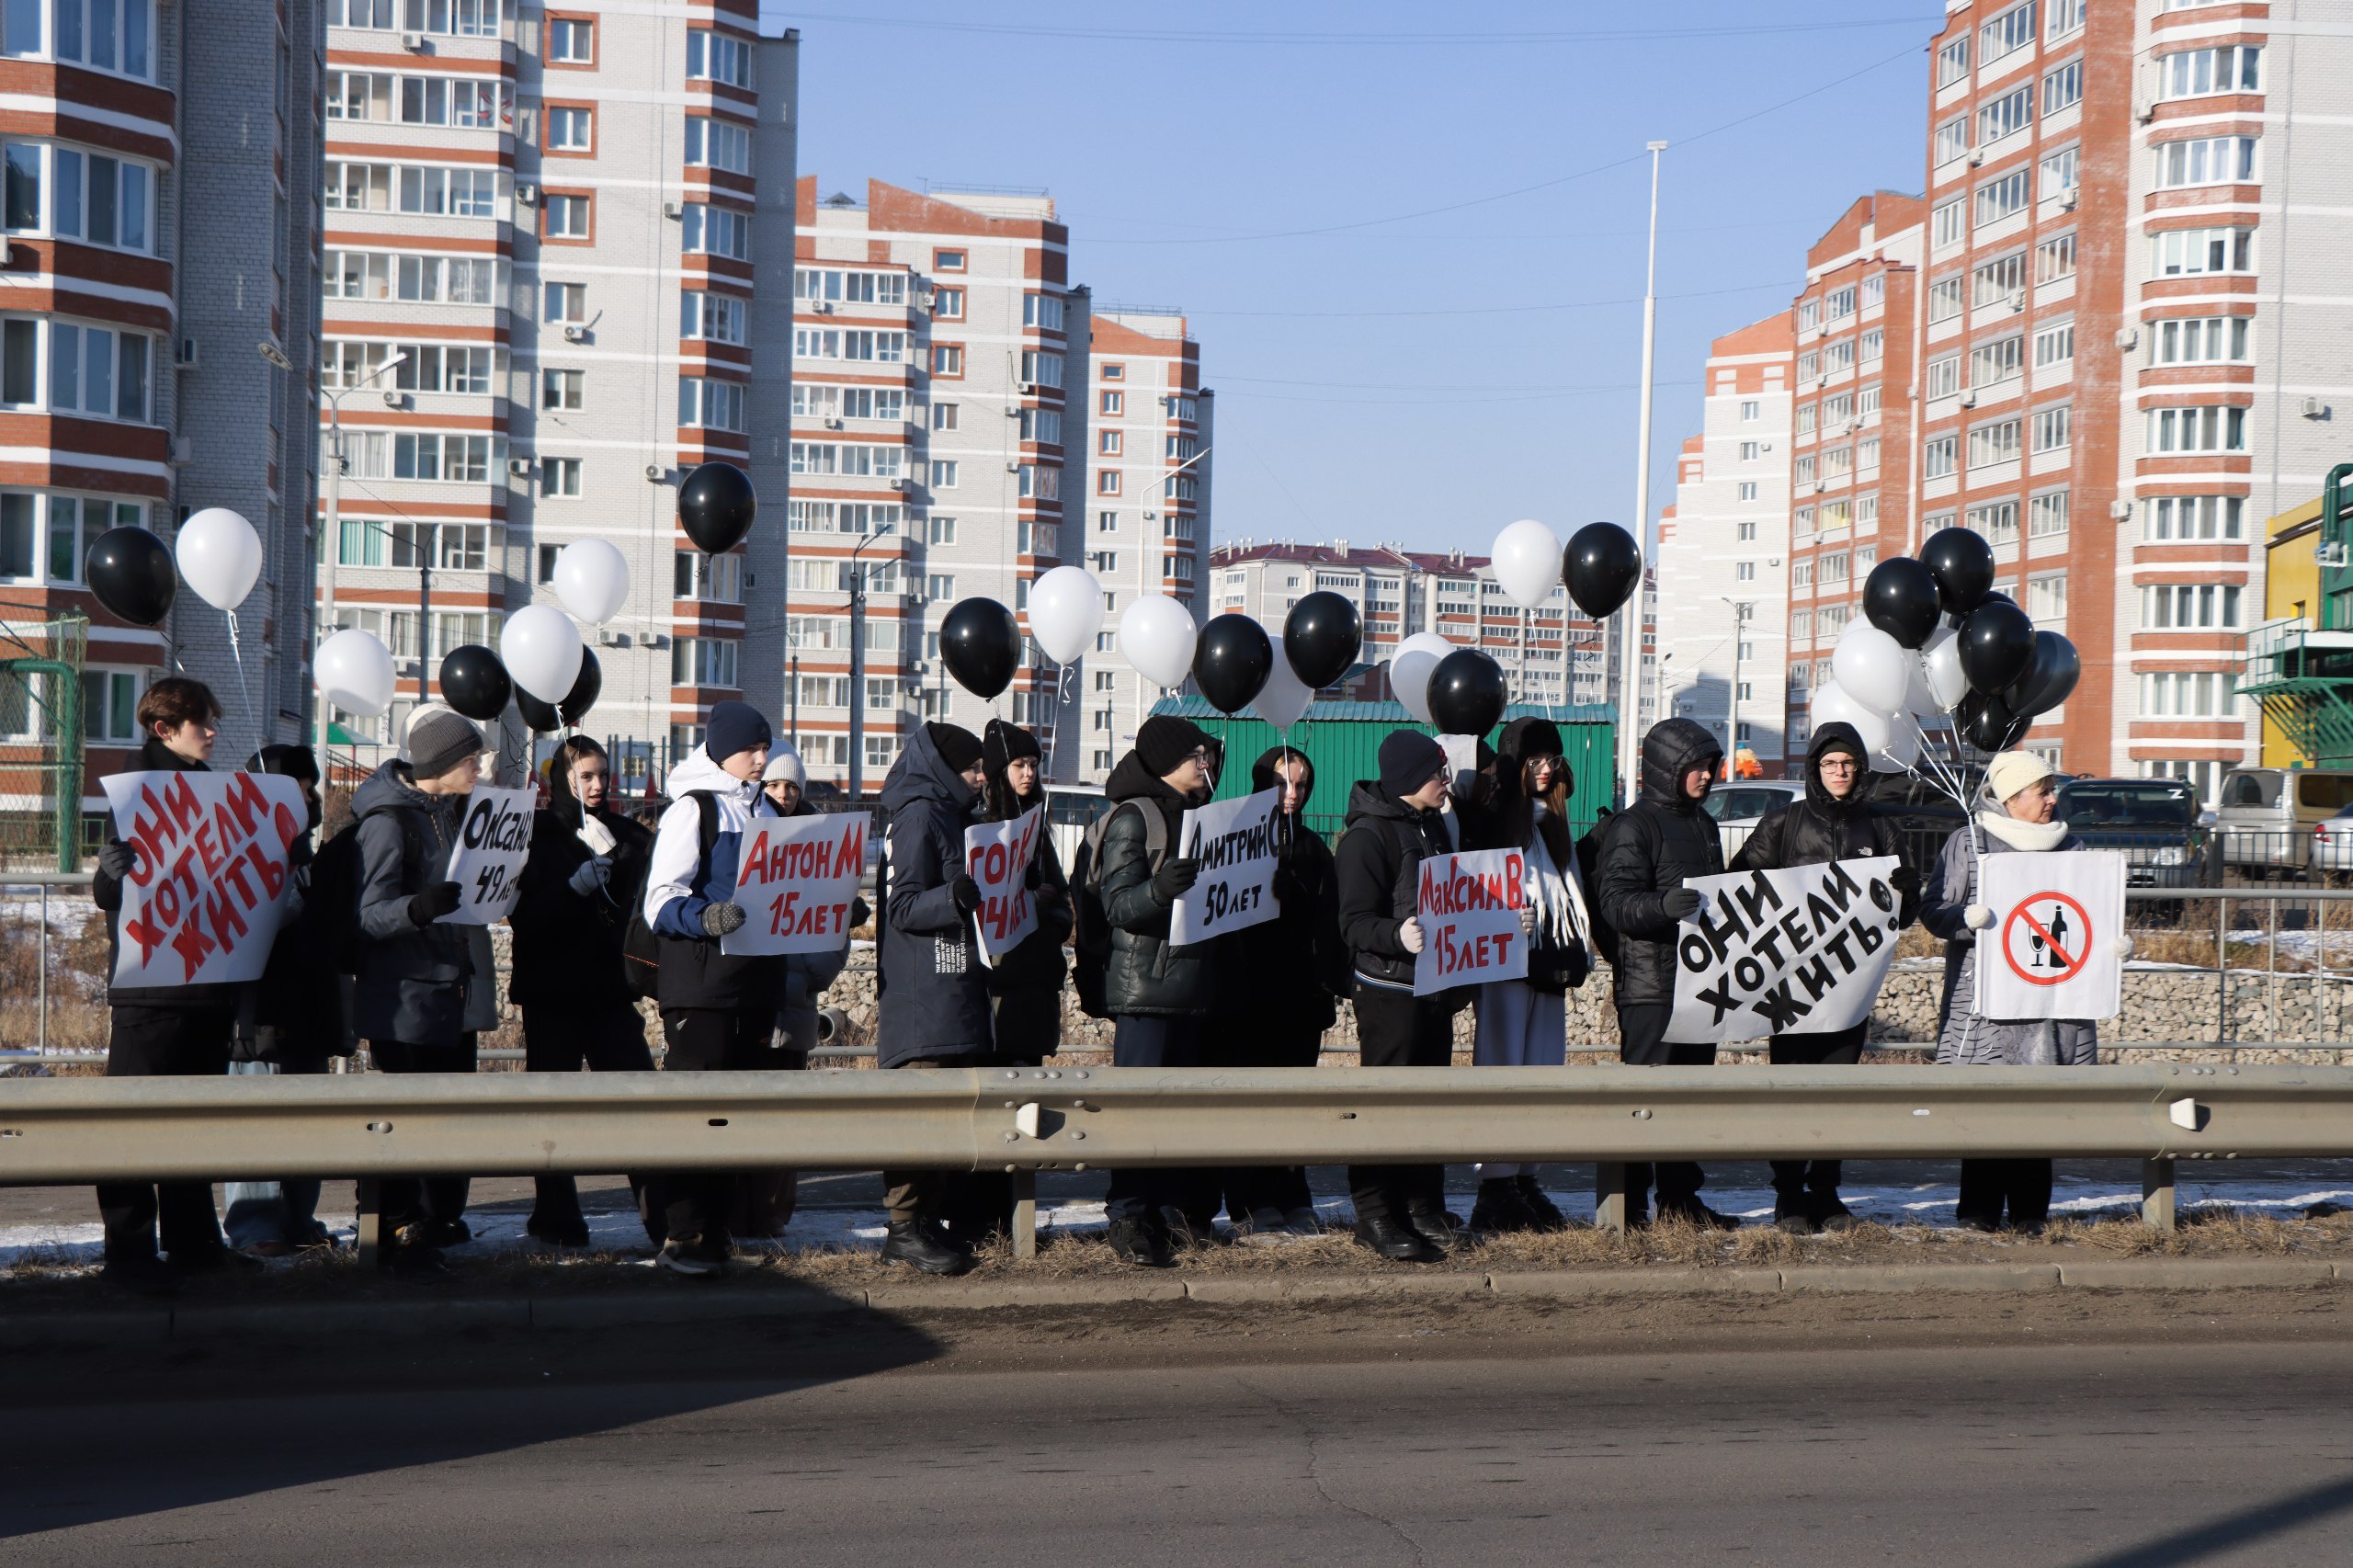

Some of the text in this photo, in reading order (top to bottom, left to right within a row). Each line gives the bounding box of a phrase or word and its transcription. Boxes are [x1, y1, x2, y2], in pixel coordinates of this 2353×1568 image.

[2166, 789, 2185, 800] Z
[128, 771, 203, 887] ОНИ
[126, 772, 270, 971] ХОТЕЛИ
[474, 864, 506, 904] 49
[769, 892, 801, 937] 15
[976, 895, 1007, 939] 14
[1203, 881, 1228, 926] 50
[1680, 869, 1783, 972] ОНИ
[1435, 924, 1457, 976] 15
[1696, 861, 1862, 1027] ХОТЕЛИ
